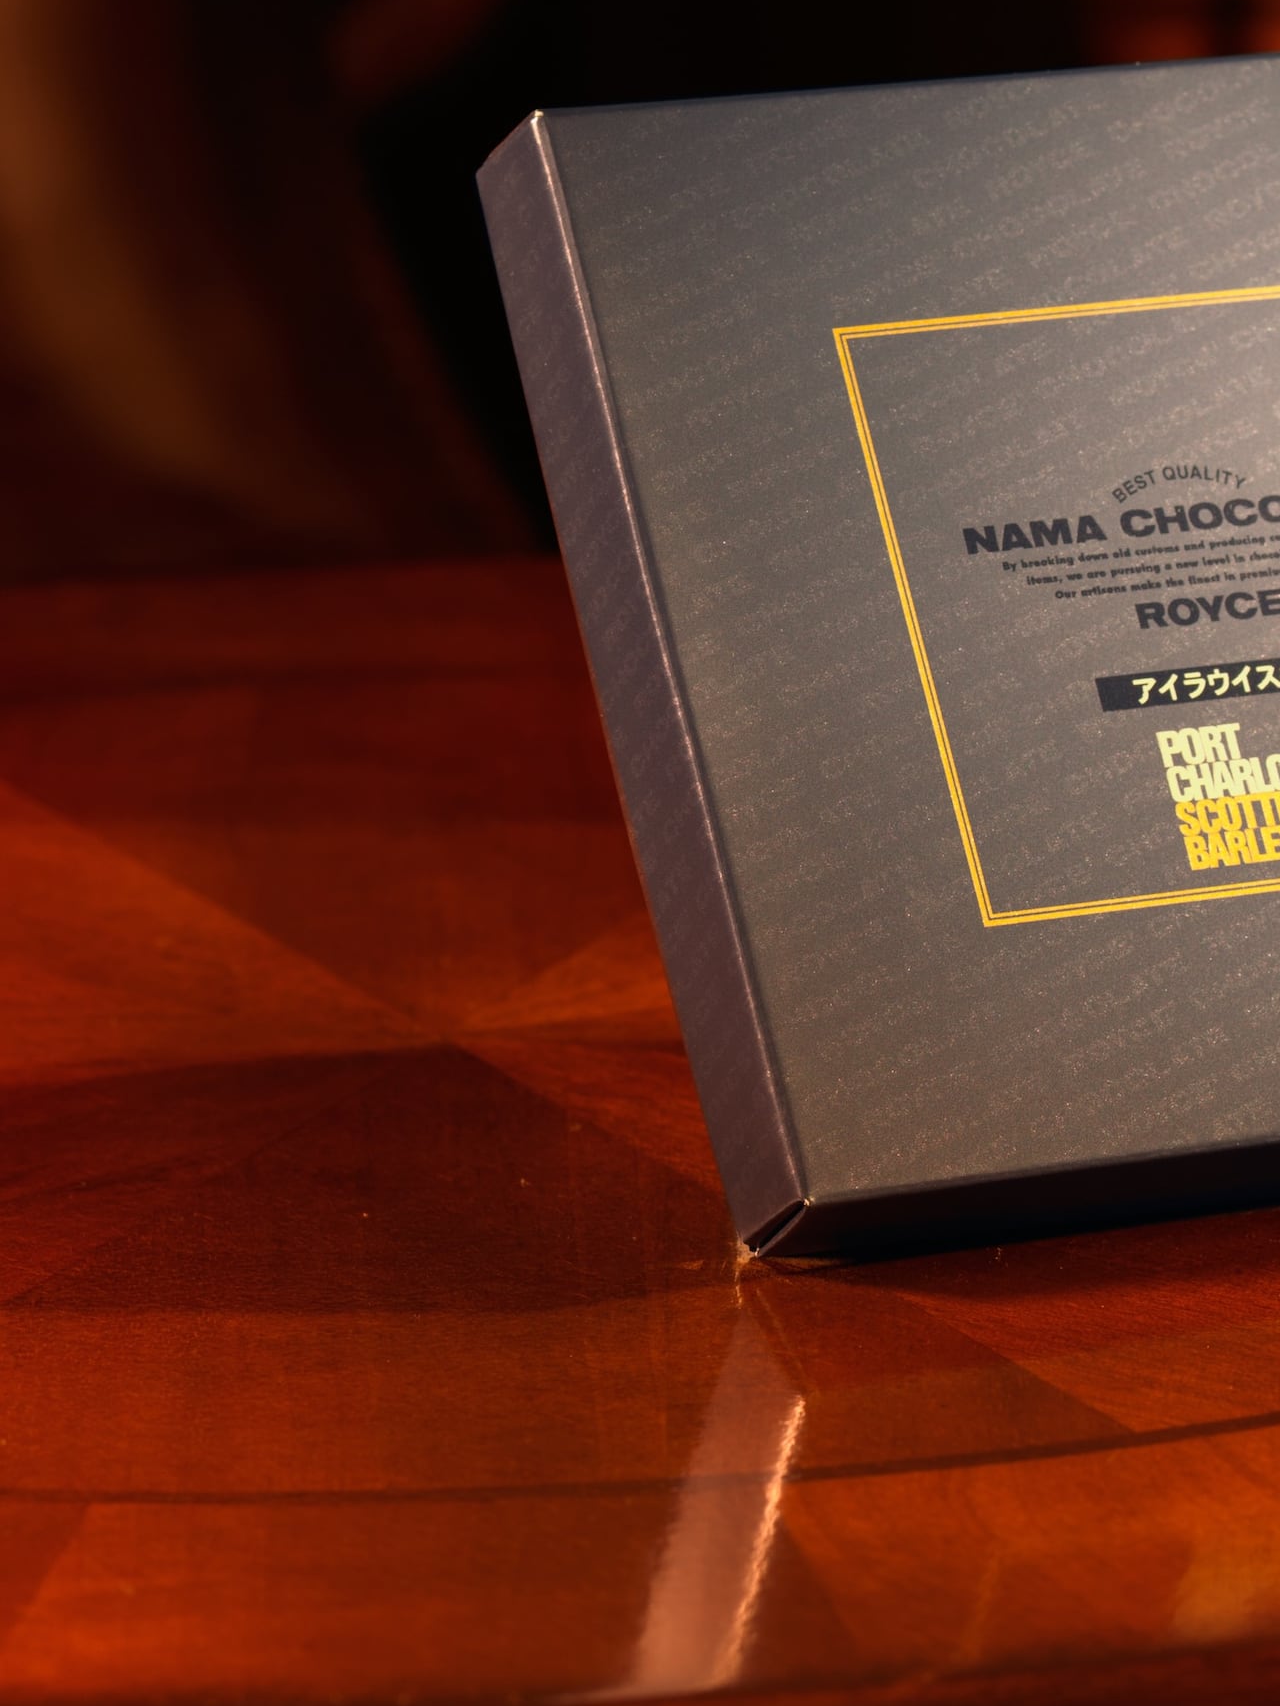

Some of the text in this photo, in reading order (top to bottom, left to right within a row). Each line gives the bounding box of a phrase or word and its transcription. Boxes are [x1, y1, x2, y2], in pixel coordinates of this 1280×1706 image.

[1112, 464, 1247, 504] BEST QUALITY
[962, 515, 1108, 555] NAMA
[1002, 561, 1017, 572] By
[1021, 554, 1075, 569] breaking
[1078, 552, 1109, 563] down
[1113, 548, 1132, 559] old
[1135, 544, 1180, 557] customs
[1184, 540, 1206, 551] and
[1209, 534, 1266, 551] producing
[1055, 589, 1077, 600] Our
[1080, 584, 1127, 597] artisans
[1130, 580, 1163, 592] make
[1165, 576, 1185, 587] the
[1188, 573, 1221, 586] finest
[1224, 572, 1237, 582] in
[1066, 572, 1083, 582] we
[1087, 569, 1107, 580] are
[1110, 562, 1161, 579] pursuing
[1164, 562, 1172, 571] a
[1176, 559, 1199, 570] new
[1202, 554, 1231, 567] level
[1234, 553, 1246, 564] in
[1156, 723, 1241, 768] PORT
